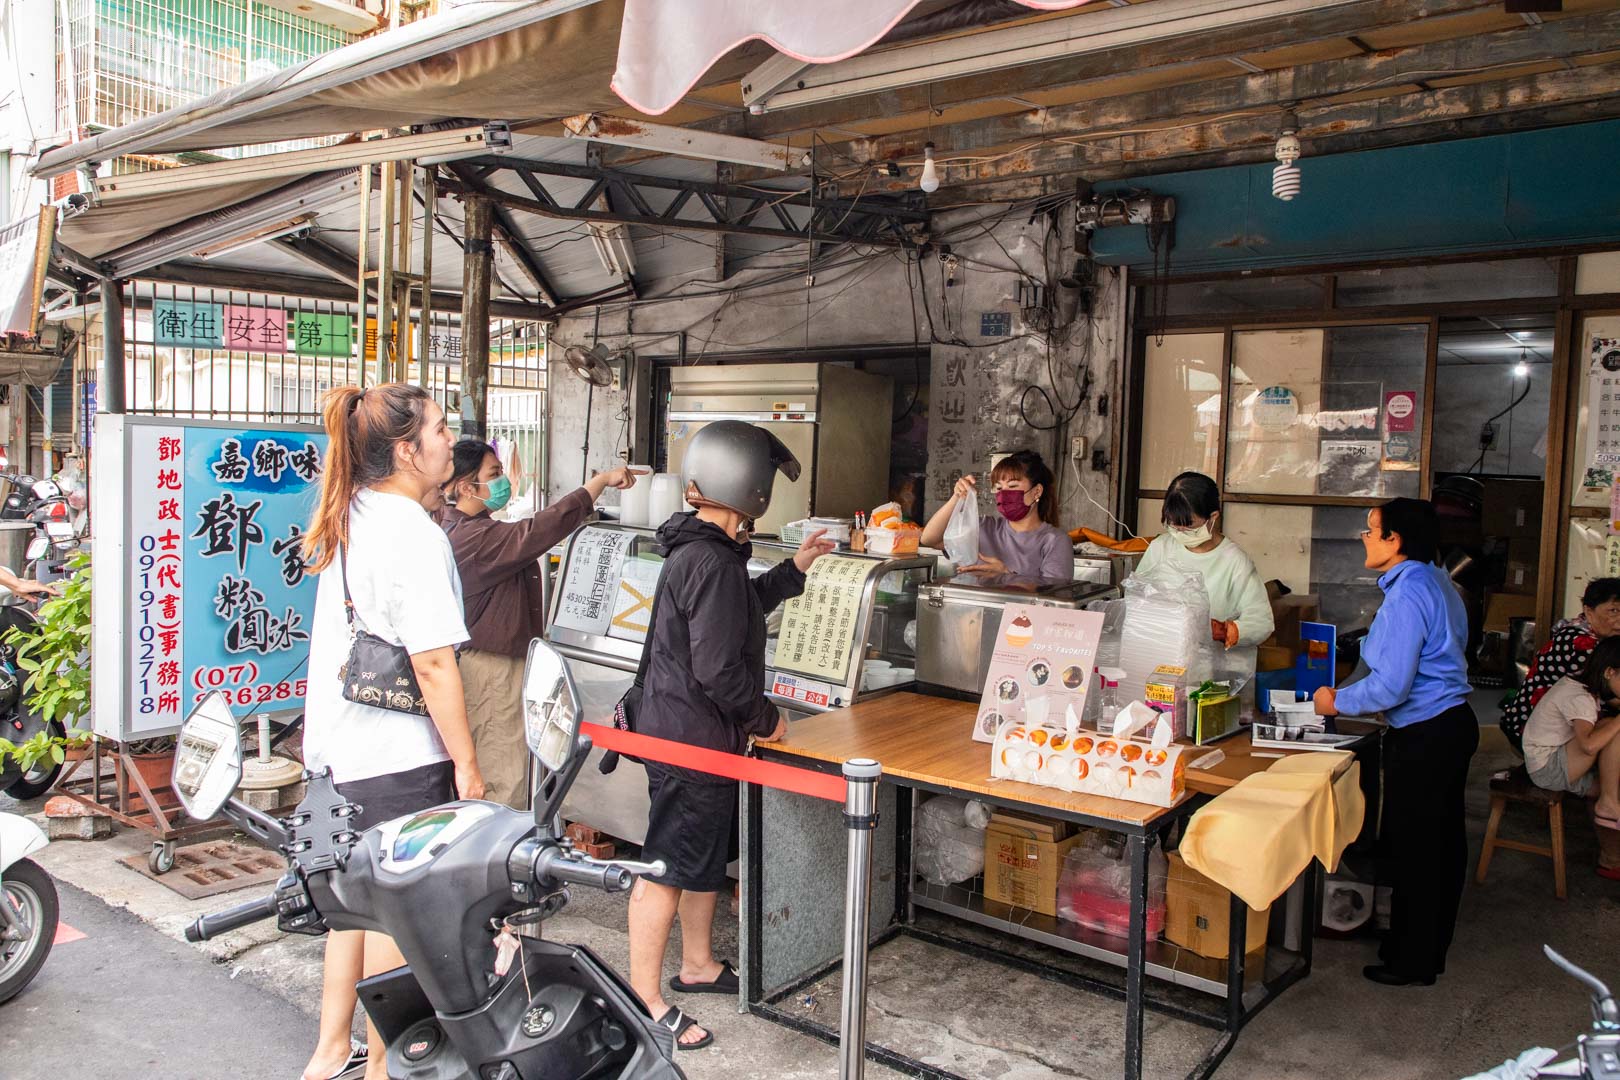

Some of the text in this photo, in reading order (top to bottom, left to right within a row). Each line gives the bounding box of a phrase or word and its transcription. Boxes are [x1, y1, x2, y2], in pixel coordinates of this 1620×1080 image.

[157, 309, 218, 340] 衛生
[228, 315, 284, 344] 安全
[297, 320, 349, 348] 第一
[215, 441, 321, 479] 嘉鄉味
[156, 437, 182, 715] 鄧地政士(代書)事務所
[139, 535, 155, 714] 0919102718
[194, 661, 258, 689] (07)
